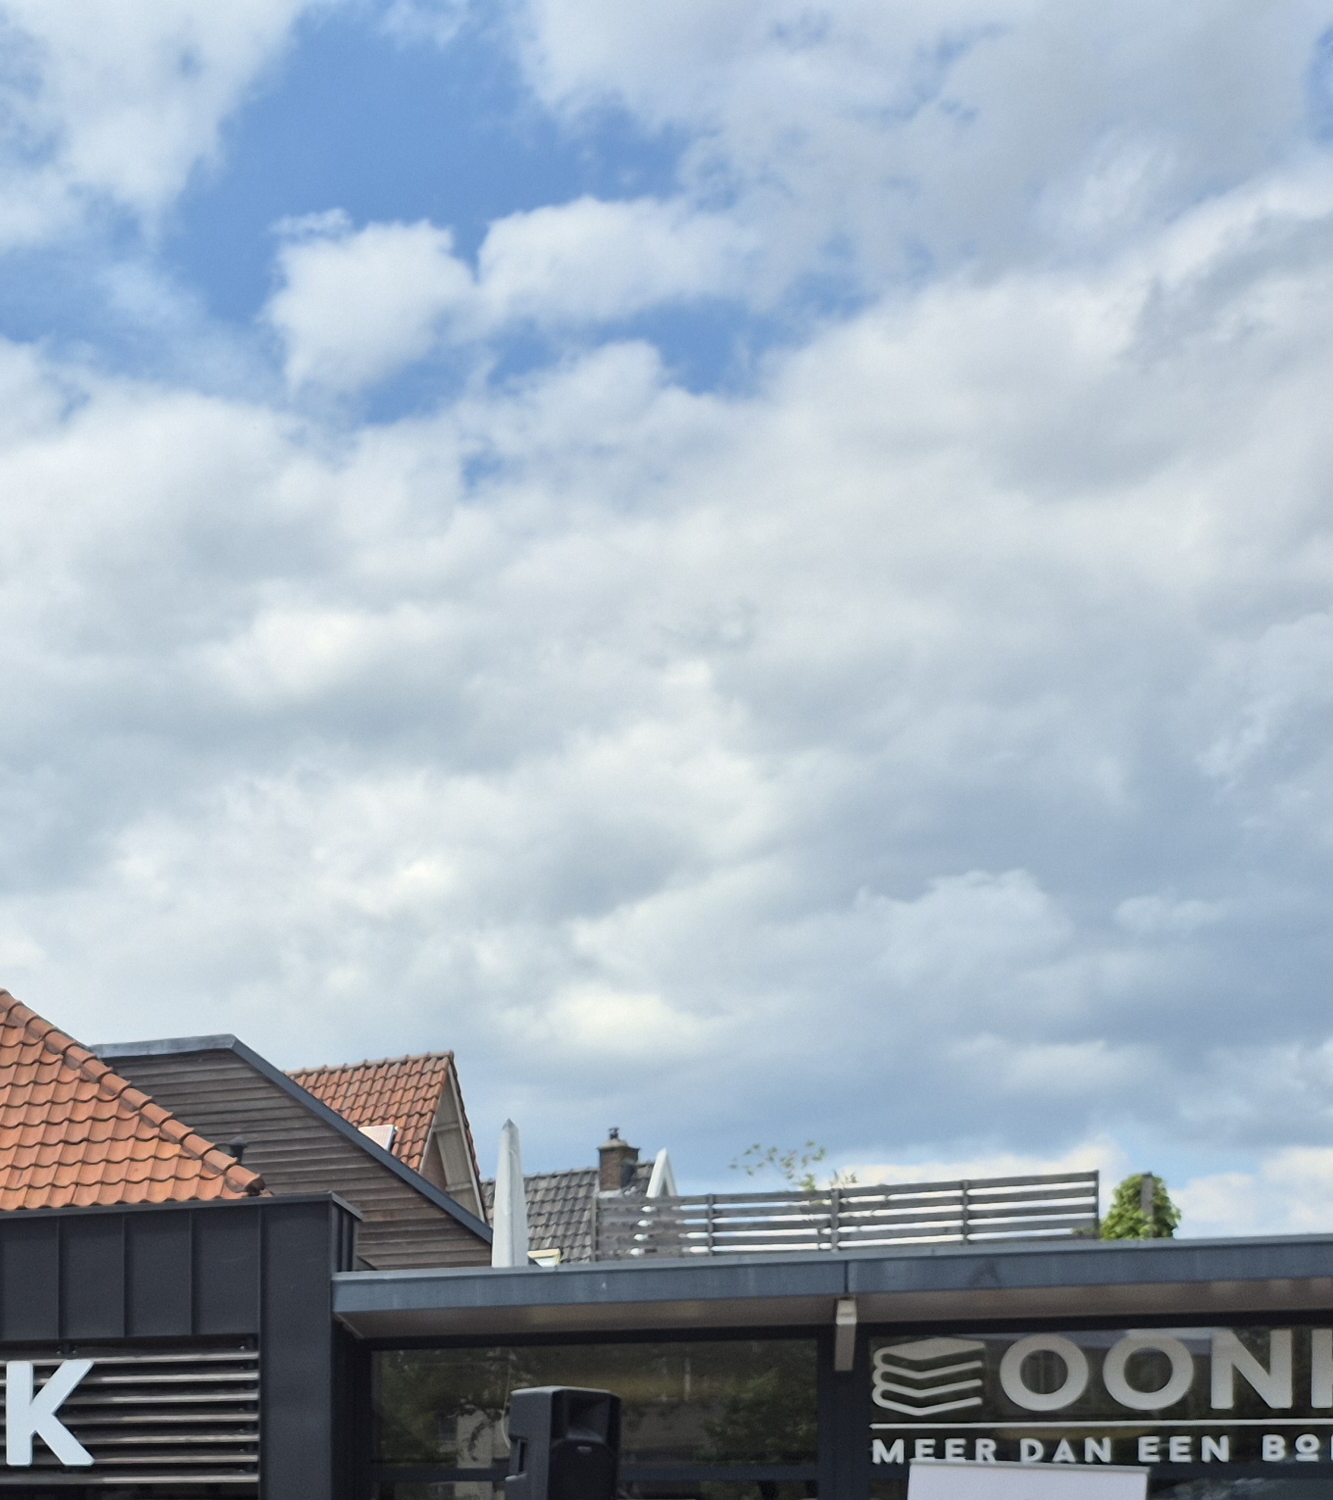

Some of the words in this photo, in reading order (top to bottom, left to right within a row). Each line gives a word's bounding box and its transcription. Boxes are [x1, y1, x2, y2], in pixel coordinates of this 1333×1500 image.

[872, 1438, 997, 1464] MEER
[1020, 1437, 1112, 1463] DAN
[1137, 1435, 1230, 1463] EEN
[1261, 1433, 1333, 1462] BO
